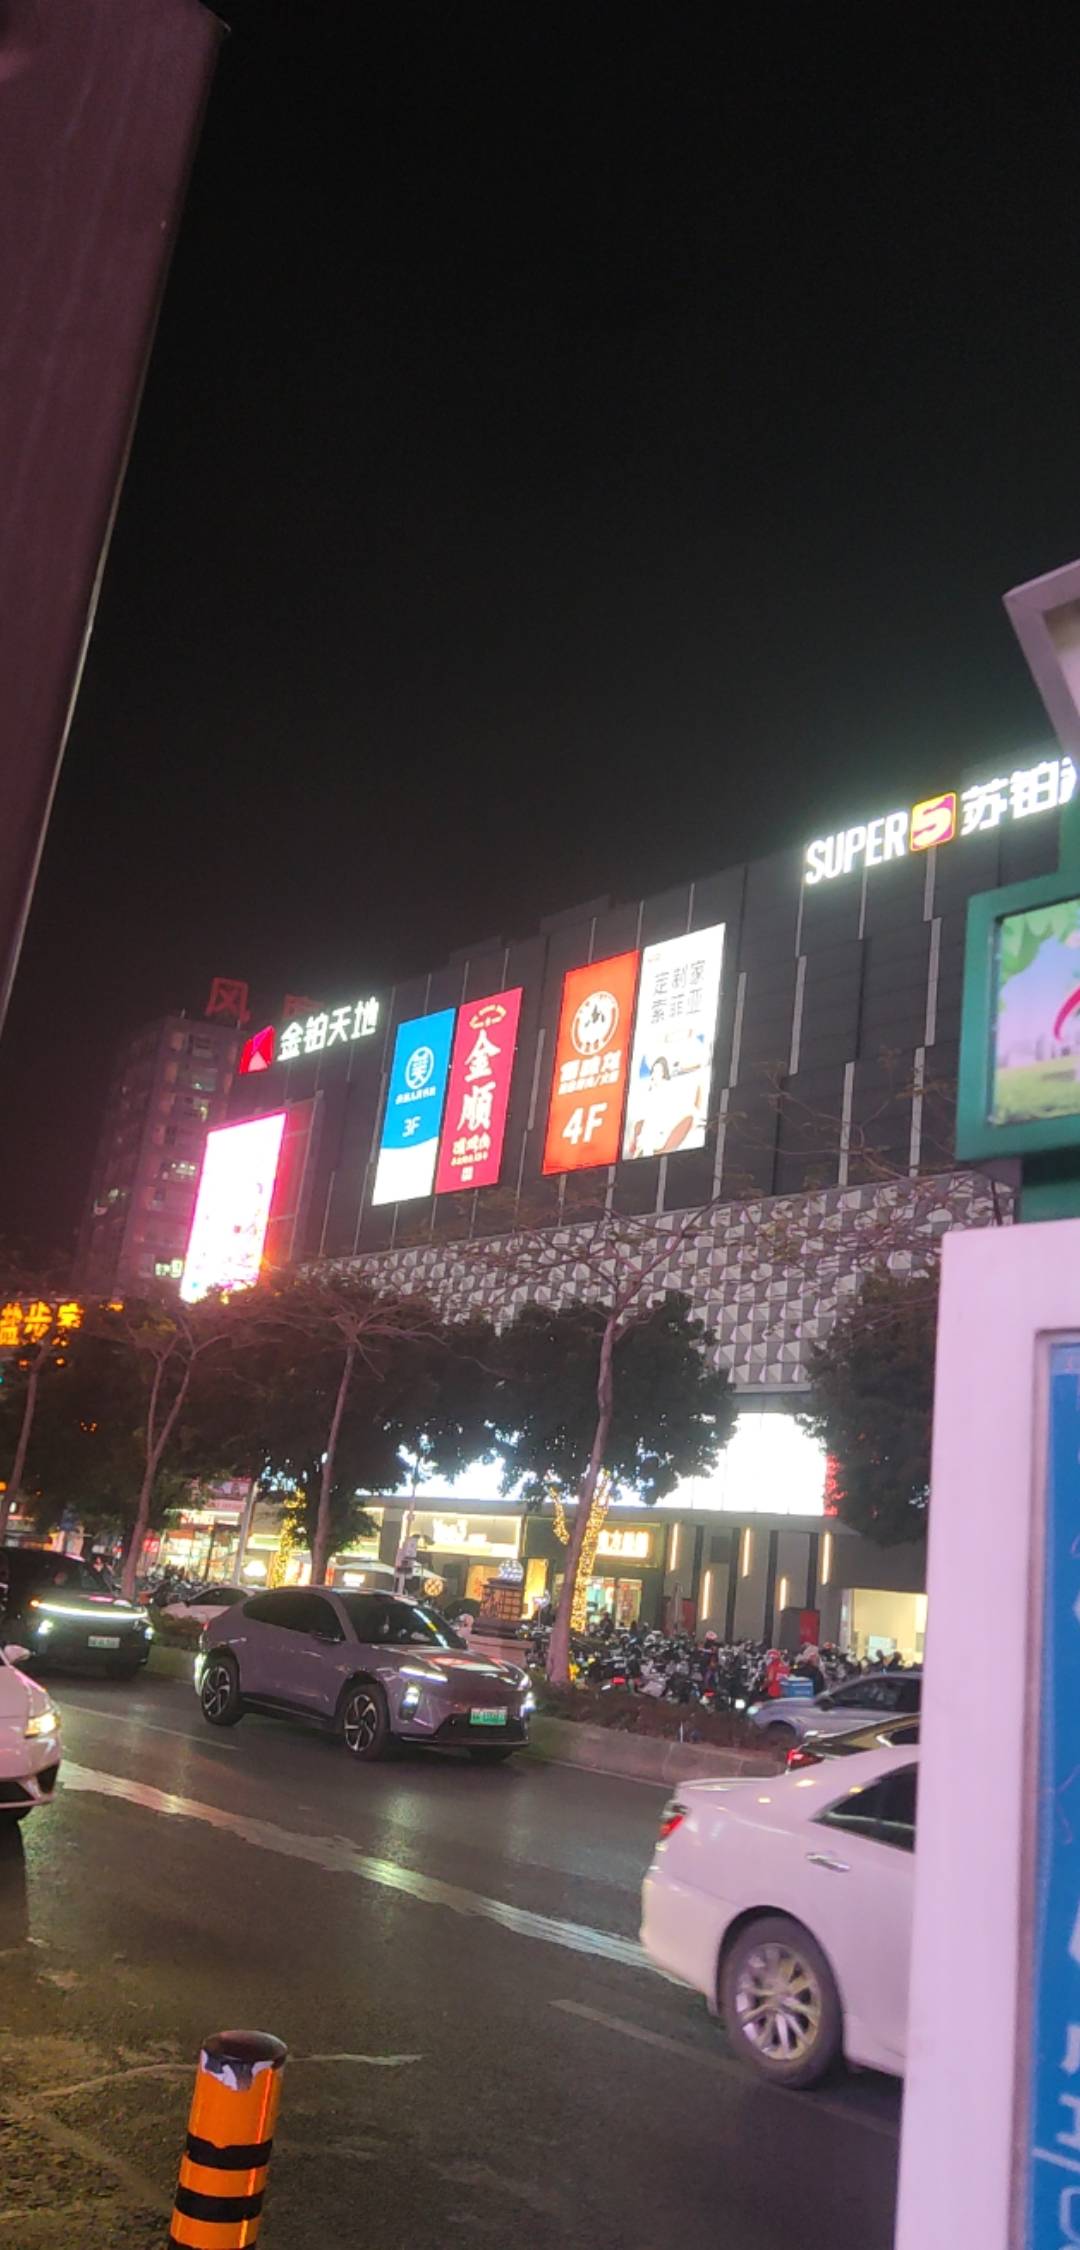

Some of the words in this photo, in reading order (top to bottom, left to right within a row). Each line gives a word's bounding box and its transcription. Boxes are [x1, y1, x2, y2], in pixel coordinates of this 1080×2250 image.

[804, 810, 909, 886] SUPER
[276, 996, 380, 1062] 金铂天地
[402, 1116, 422, 1138] 3F
[561, 1103, 608, 1145] 4F
